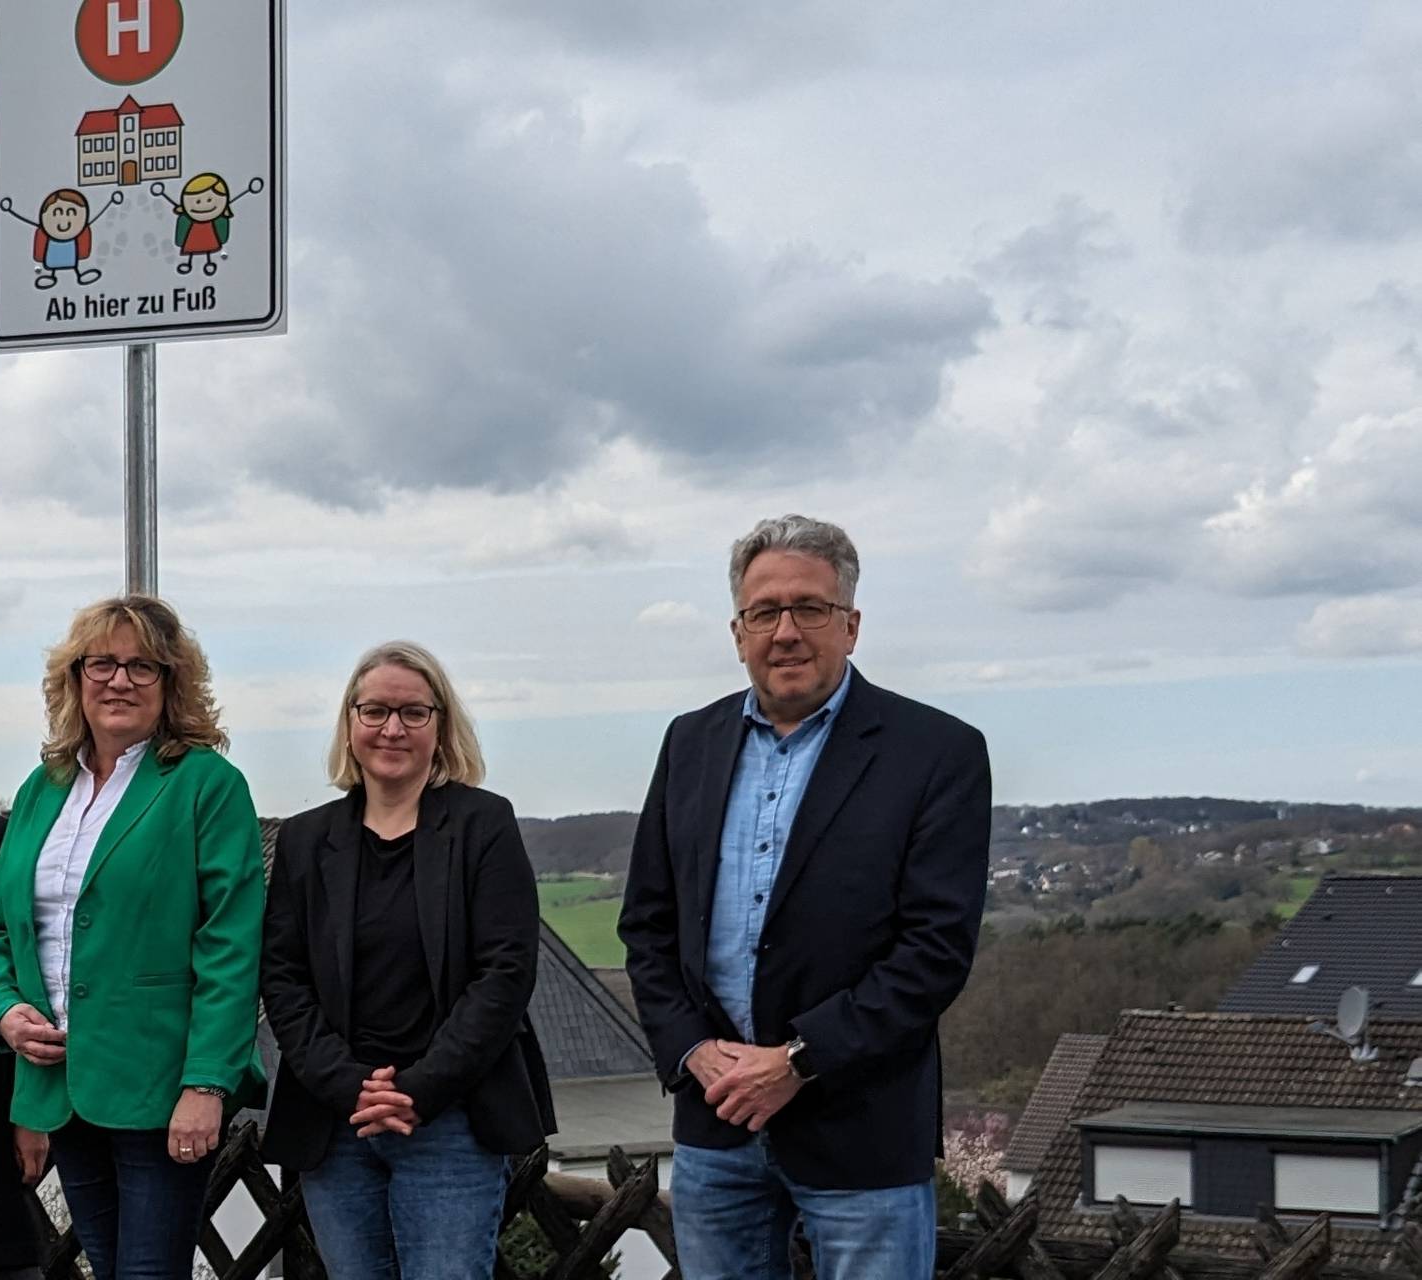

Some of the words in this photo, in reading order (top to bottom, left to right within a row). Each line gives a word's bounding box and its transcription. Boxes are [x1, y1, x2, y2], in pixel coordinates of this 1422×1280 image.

[107, 0, 150, 57] H
[46, 297, 76, 321] Ab
[84, 294, 130, 319] hier
[137, 294, 164, 315] zu
[173, 285, 216, 313] Fuß
